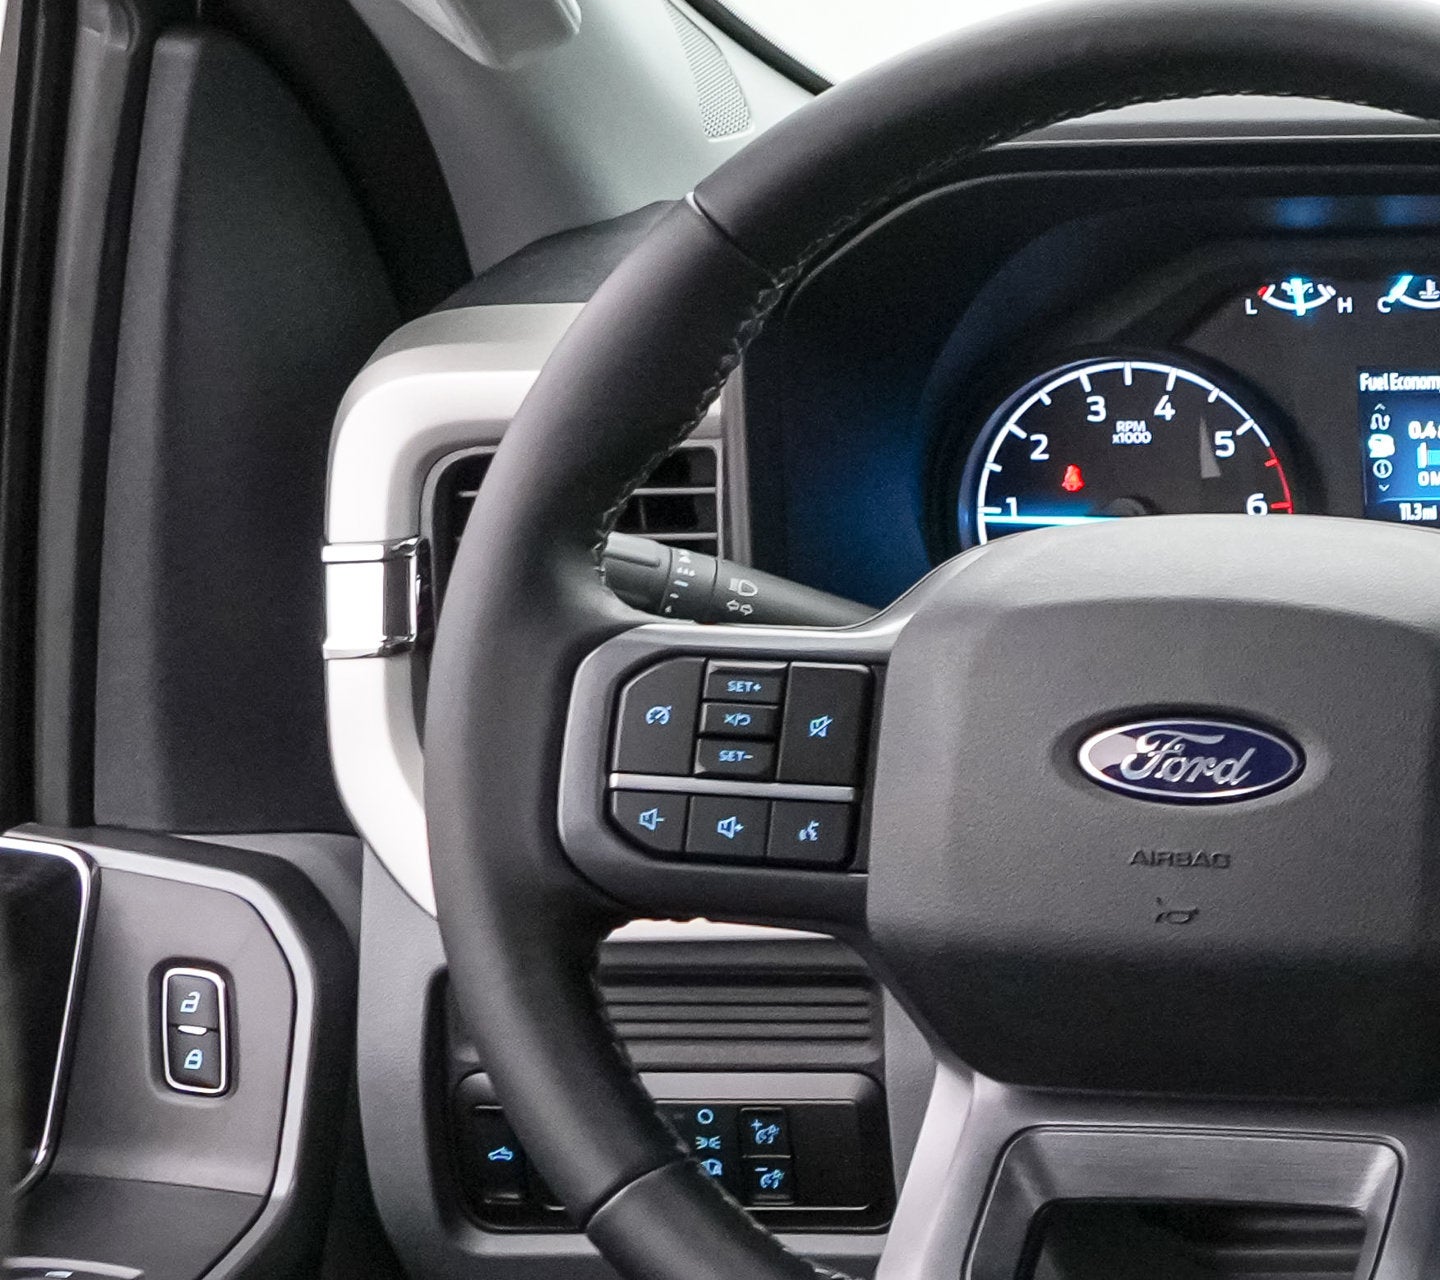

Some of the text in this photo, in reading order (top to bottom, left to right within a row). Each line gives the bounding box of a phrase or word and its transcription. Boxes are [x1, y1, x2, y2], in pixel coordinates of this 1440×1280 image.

[1338, 297, 1353, 314] H
[1377, 297, 1391, 313] C
[1359, 373, 1388, 392] Fuel
[1087, 396, 1107, 422] 3
[1155, 395, 1175, 420] 4
[1116, 421, 1147, 433] RPM
[1408, 421, 1437, 440] 0.4
[1030, 434, 1049, 460] 2
[1214, 431, 1236, 457] 5
[1005, 498, 1018, 517] 1
[1247, 493, 1267, 516] 6
[1120, 730, 1256, 786] Ford
[1130, 849, 1231, 869] AIRBAG
